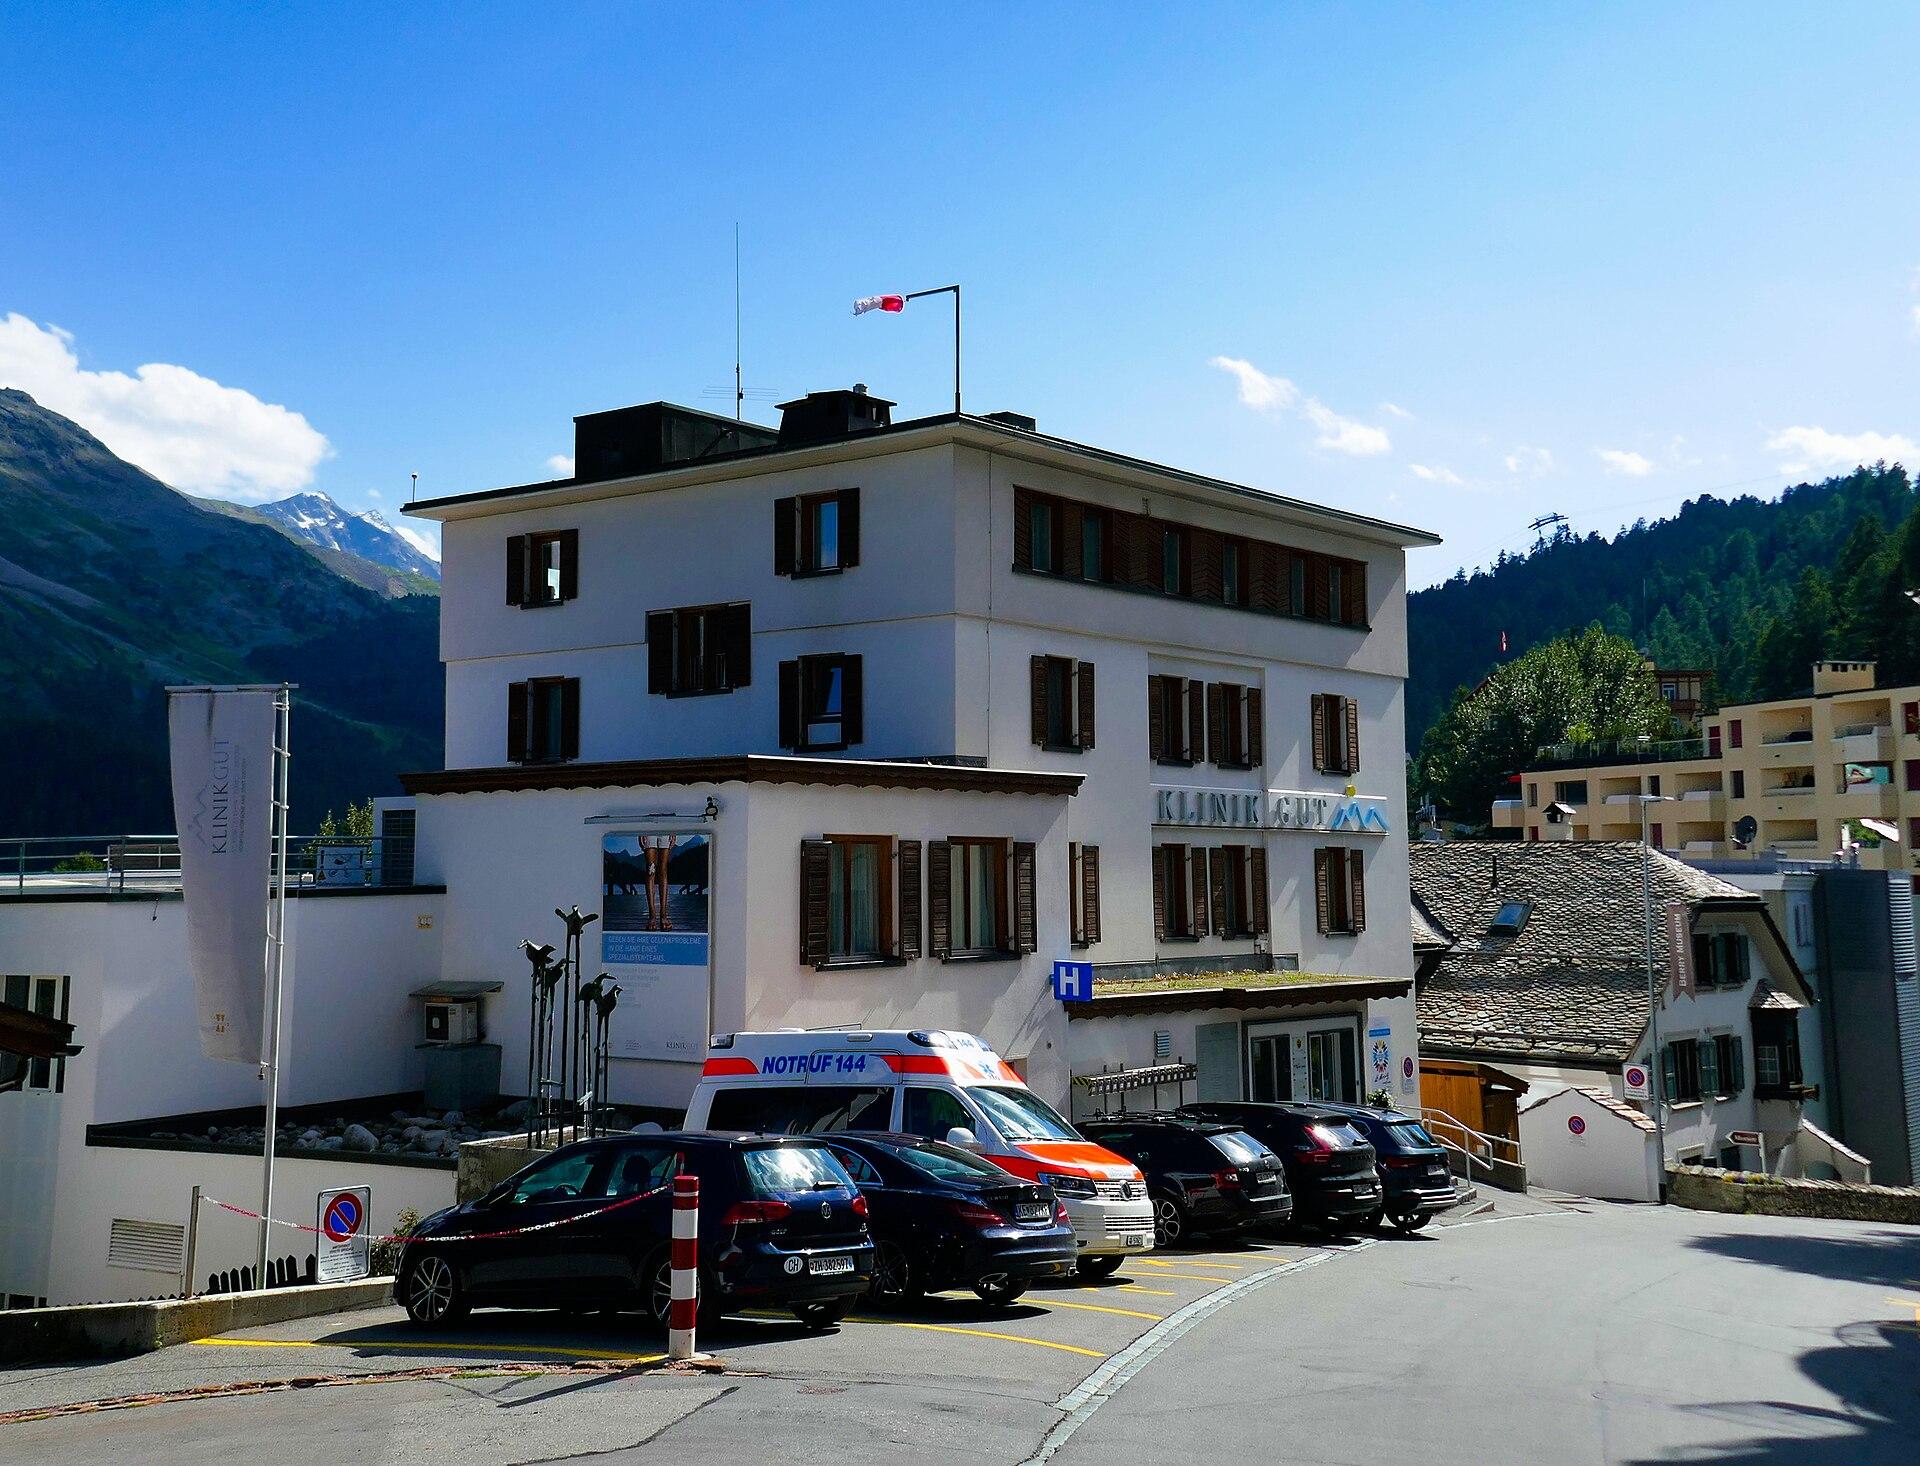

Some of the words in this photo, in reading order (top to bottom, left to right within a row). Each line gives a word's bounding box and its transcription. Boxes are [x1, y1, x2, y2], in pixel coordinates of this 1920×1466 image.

[1157, 789, 1259, 824] KLINIK
[1274, 795, 1327, 827] GUT
[1673, 913, 1684, 953] MUSEUM
[1060, 966, 1079, 996] H
[1678, 955, 1687, 987] BERRY
[957, 1038, 975, 1049] 144
[762, 1054, 831, 1074] NOTRUF
[835, 1054, 866, 1073] 144
[788, 1259, 799, 1272] CH
